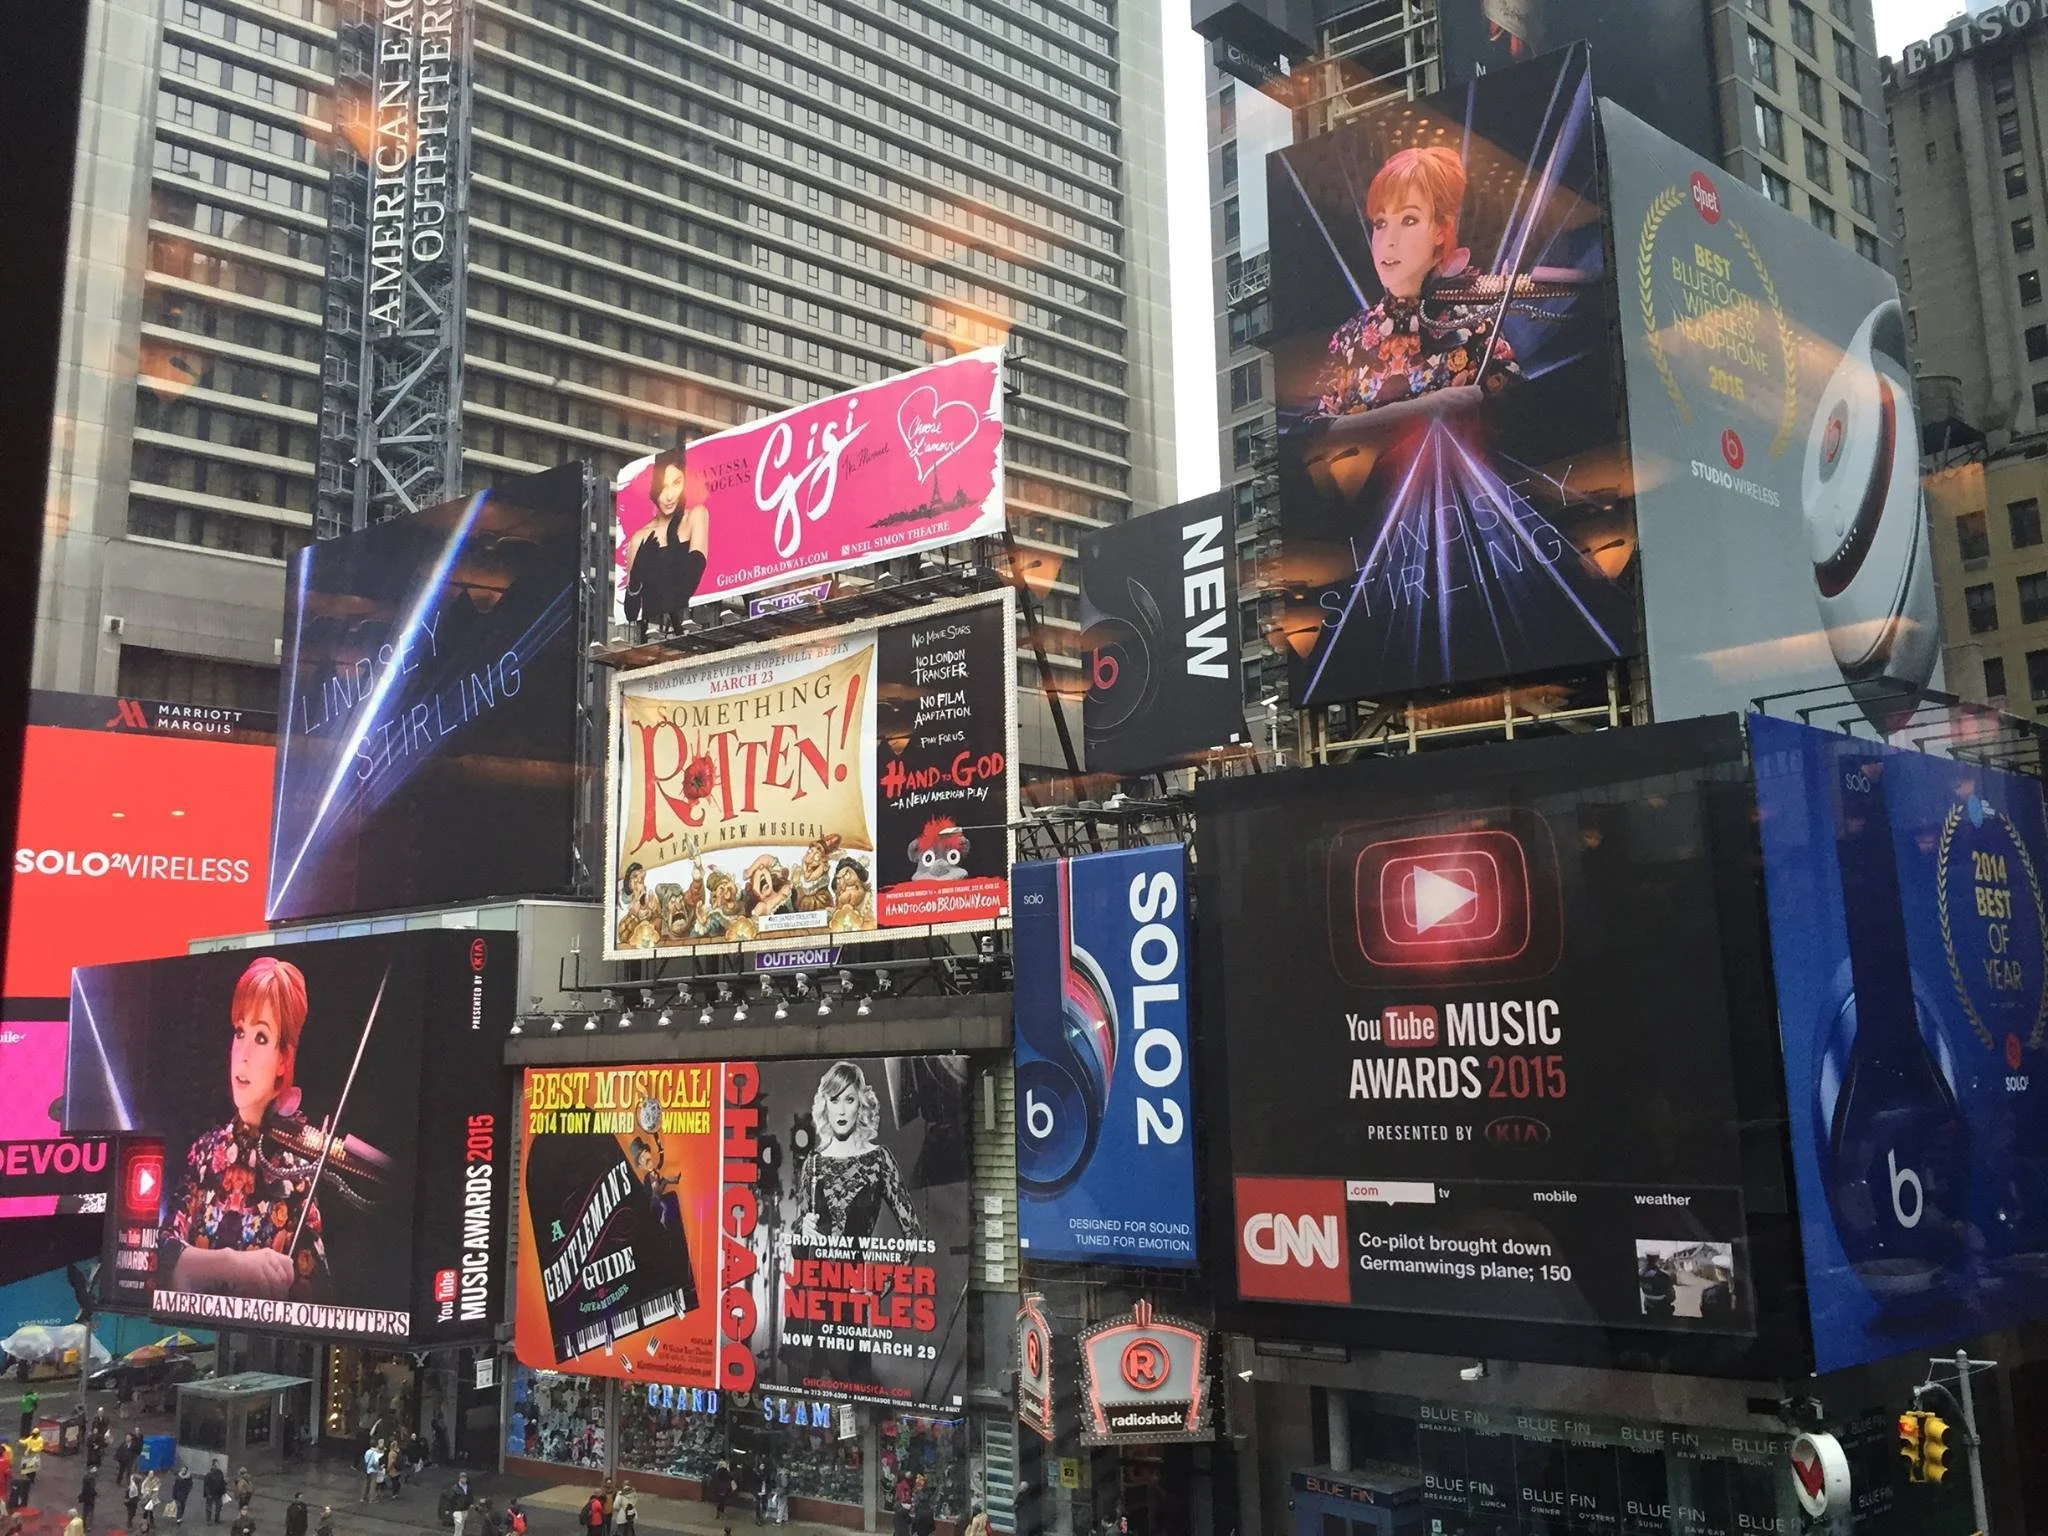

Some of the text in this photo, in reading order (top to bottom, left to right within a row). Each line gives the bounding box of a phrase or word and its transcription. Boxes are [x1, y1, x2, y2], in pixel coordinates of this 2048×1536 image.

[412, 0, 453, 262] OUTFITTER
[369, 0, 413, 328] AMERICAN EA
[1694, 243, 1731, 281] BEST
[1671, 256, 1760, 322] BLUETOOTH
[1683, 287, 1756, 344] WIRELESS
[1672, 307, 1769, 376] HEADPHONE
[1708, 364, 1744, 400] 2015
[755, 398, 872, 558] Gigi
[1350, 464, 1573, 573] LINDSEY
[851, 521, 950, 554] NEIL SIMON THEATRE
[1319, 524, 1563, 628] STIRLING
[1182, 515, 1229, 680] NEW
[302, 611, 440, 735] LINDSEY
[648, 642, 849, 693] BROADWAY PREVIEWS HOPEFULLY BEGIN
[916, 649, 965, 668] NO LONDON
[710, 670, 774, 694] MARCH 23
[158, 705, 243, 722] MARRIOTT
[656, 673, 832, 728] SOMETHING
[920, 689, 966, 710] NO FILM
[158, 718, 232, 735] MARQUIS
[356, 651, 522, 780] STIRLING
[880, 760, 940, 799] HAND
[951, 751, 1005, 788] GOD
[1845, 771, 1871, 794] solo
[906, 786, 989, 809] NEW AMERICAN PLAY
[720, 823, 748, 841] NEW
[759, 822, 826, 838] MUSICAL
[1972, 850, 2008, 884] 2014
[1023, 892, 1045, 905] solo
[1975, 886, 2013, 920] BEST
[1988, 923, 2010, 954] OF
[763, 949, 831, 967] OUTFRONT
[472, 941, 484, 1030] PRESENTED BY KIA
[1983, 959, 2023, 992] YEAR
[1129, 870, 1185, 1146] SOLO 2
[1345, 999, 1562, 1047] YouTube MUSIC
[530, 1069, 712, 1110] BEST MUSICAL!
[1349, 1055, 1567, 1100] AWARDS 2015
[529, 1111, 711, 1135] 2014 TONY AWARD WINNER
[1367, 1125, 1539, 1143] PRESENTED BY KIA
[0, 1142, 107, 1176] EVOU
[1350, 1185, 1691, 1206] .com tv mobile weather
[460, 1114, 494, 1321] MUSIC AWARDS 2015
[543, 1160, 633, 1302] GENTLEMAN'S
[551, 1219, 566, 1243] A
[720, 1062, 761, 1390] CHICAGO
[1069, 1218, 1192, 1235] DESIGNED FOR SOUND.
[784, 1233, 937, 1253] BROADWAY WELCOMES
[862, 1250, 902, 1263] WINNER
[1075, 1234, 1193, 1251] TUNED FOR EMOTION.
[1243, 1212, 1340, 1270] CNN
[1358, 1231, 1552, 1257] Co-pilot brought down
[582, 1246, 637, 1291] GUIDE
[784, 1259, 937, 1296] JENNIFER
[1360, 1255, 1572, 1283] Germanwings plane; 150
[437, 1271, 456, 1323] YouTube
[784, 1289, 937, 1333] NETTLES
[153, 1291, 409, 1336] AMERICAN EAGLE OUTFITTERS
[782, 1332, 937, 1360] NOW THRU MARCH 29
[821, 1324, 893, 1340] OF SUGARLAND
[648, 1383, 719, 1414] GRAND
[763, 1396, 831, 1428] SLAM
[1112, 1411, 1183, 1428] radioshack
[1420, 1405, 1489, 1425] BLUE FIN
[1419, 1423, 1461, 1433] BREAKFAST
[1517, 1416, 1591, 1436] BLUE FIN
[1621, 1426, 1700, 1448] BLUE FIN
[1732, 1438, 1778, 1456] BLUE
[1306, 1477, 1345, 1498] BLUE
[1423, 1491, 1506, 1509] BREAKFAST LUNCH
[1424, 1475, 1495, 1496] BLUE FIN
[1522, 1487, 1596, 1509] BLUE FIN
[1531, 1506, 1616, 1523] DINNER OYSTERS
[1627, 1501, 1706, 1523] BLUE FIN
[1638, 1519, 1663, 1529] SUSHI
[1739, 1514, 1785, 1532] BLUE
